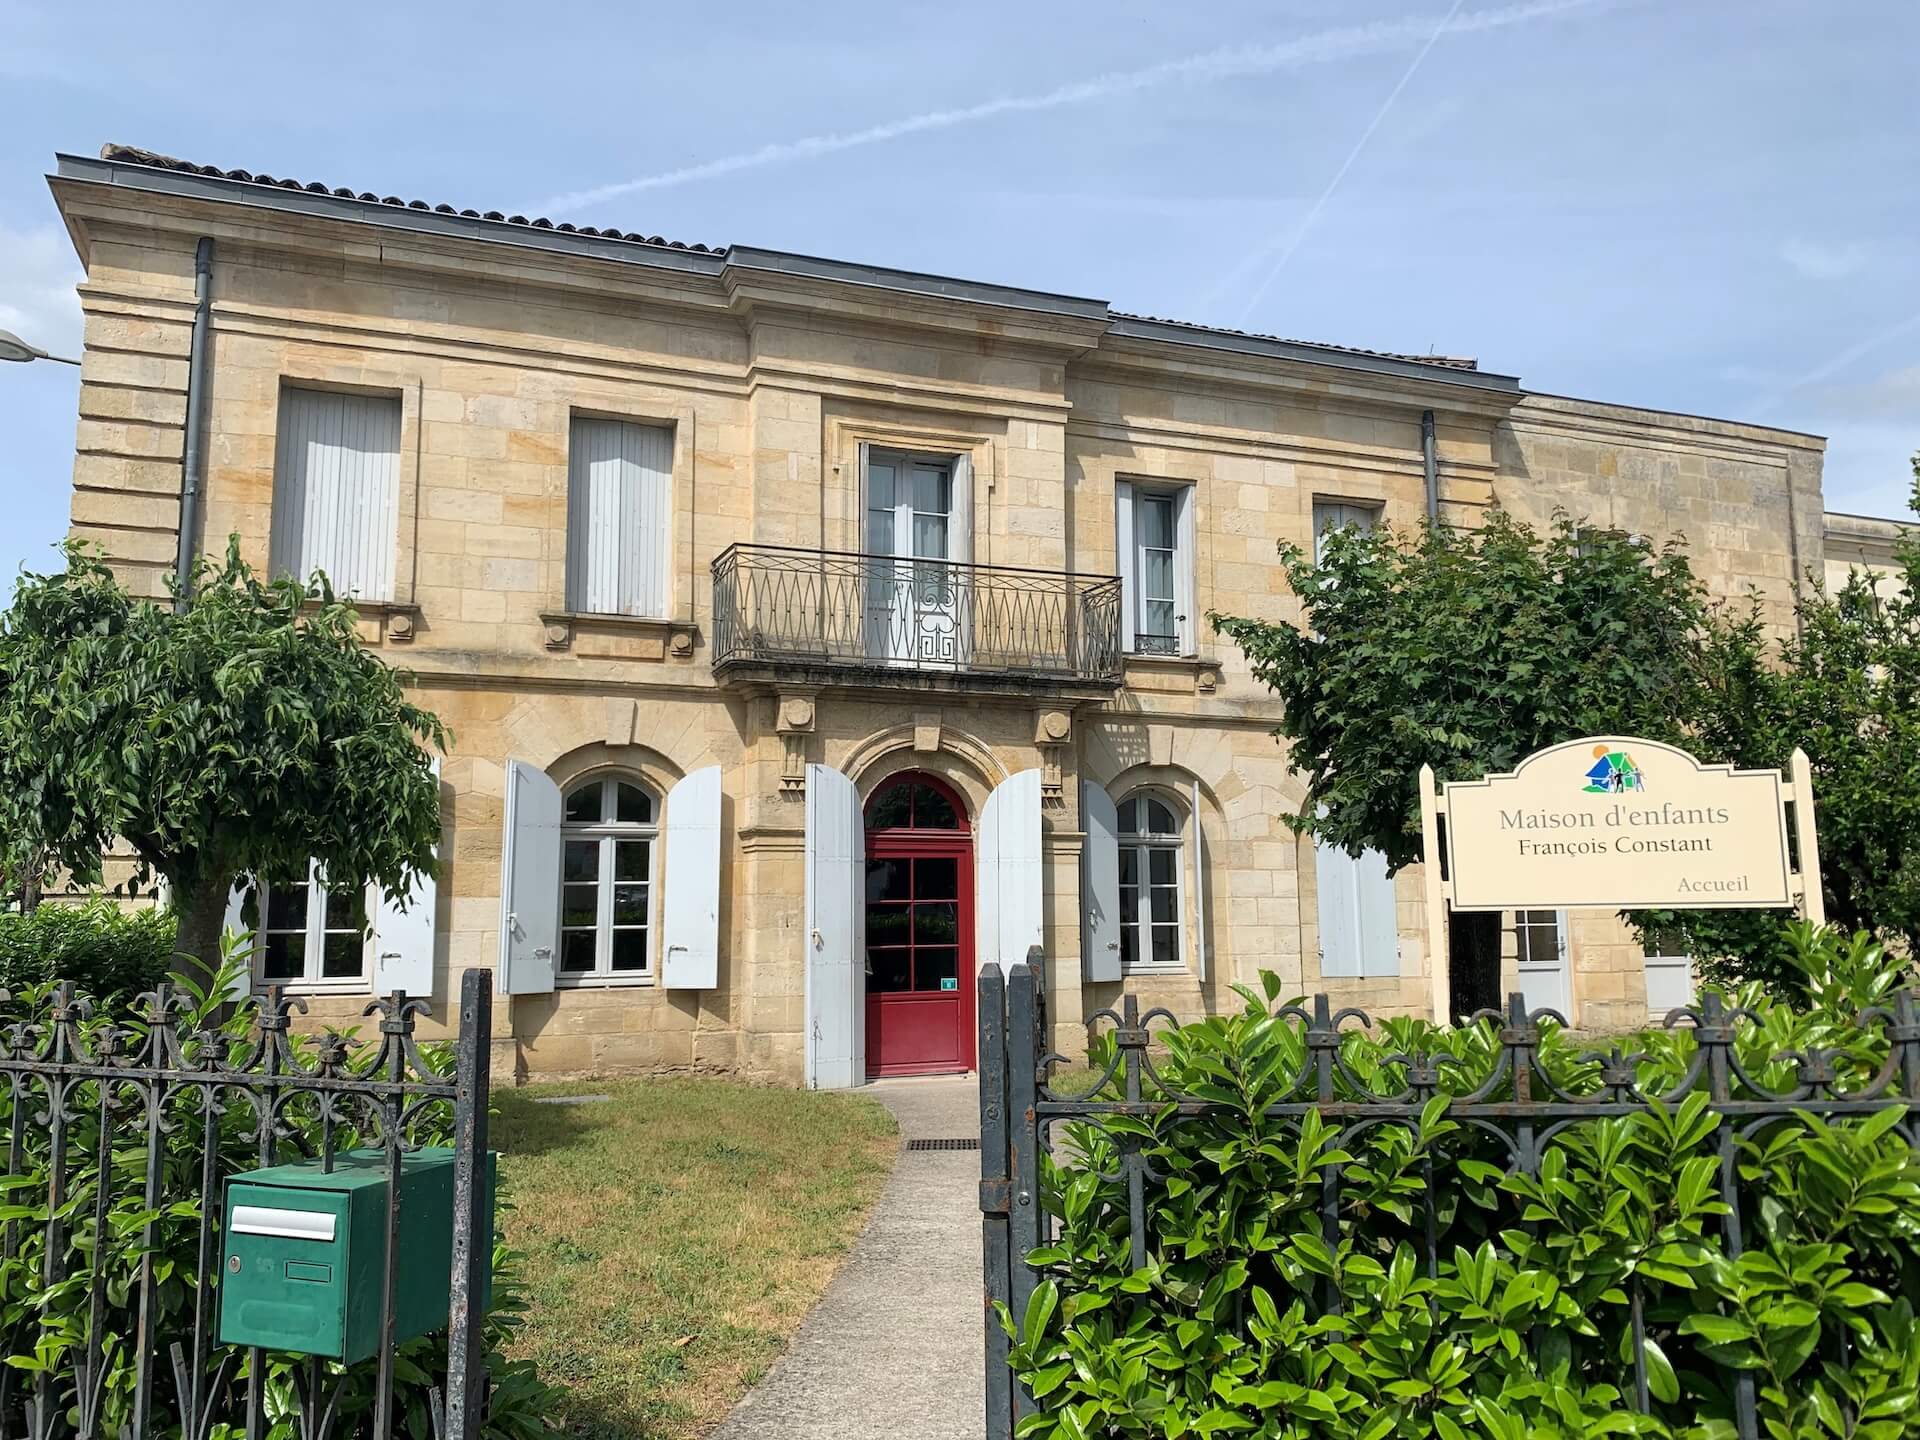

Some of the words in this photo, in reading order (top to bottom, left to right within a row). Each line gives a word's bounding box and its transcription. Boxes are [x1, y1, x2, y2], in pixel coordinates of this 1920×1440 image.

[1500, 808, 1595, 830] Maison
[1605, 802, 1729, 827] d'enfants
[1518, 837, 1608, 857] François
[1615, 835, 1713, 854] Constant
[1677, 874, 1749, 893] Accueil
